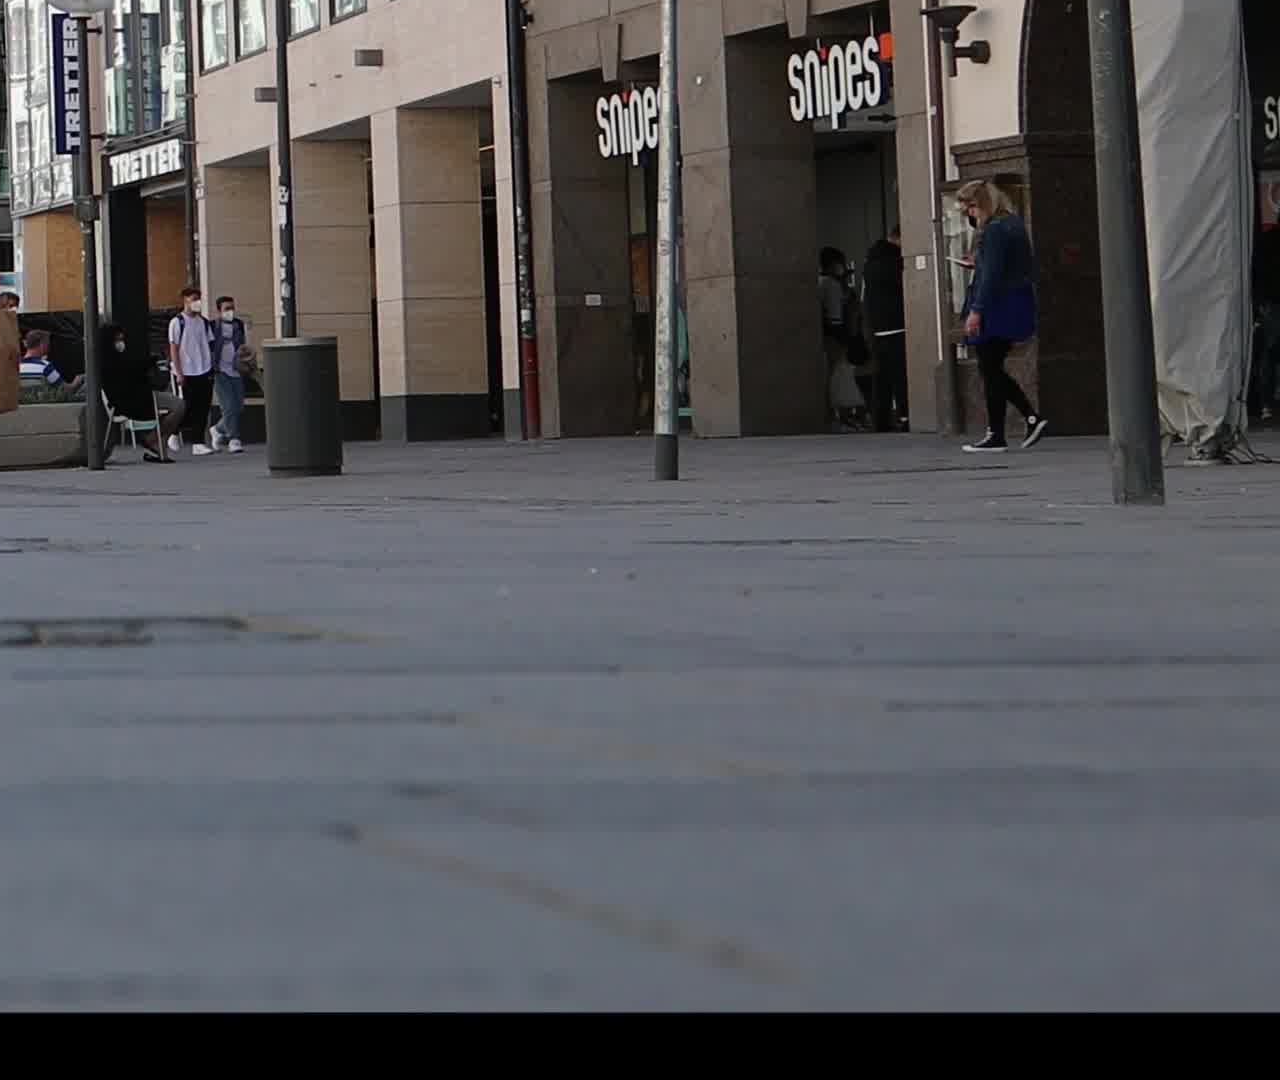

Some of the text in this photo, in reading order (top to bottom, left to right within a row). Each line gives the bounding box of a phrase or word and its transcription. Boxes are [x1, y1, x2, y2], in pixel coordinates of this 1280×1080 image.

[63, 16, 81, 151] TRETTER
[788, 36, 881, 130] snipes
[109, 137, 183, 188] TRETTER
